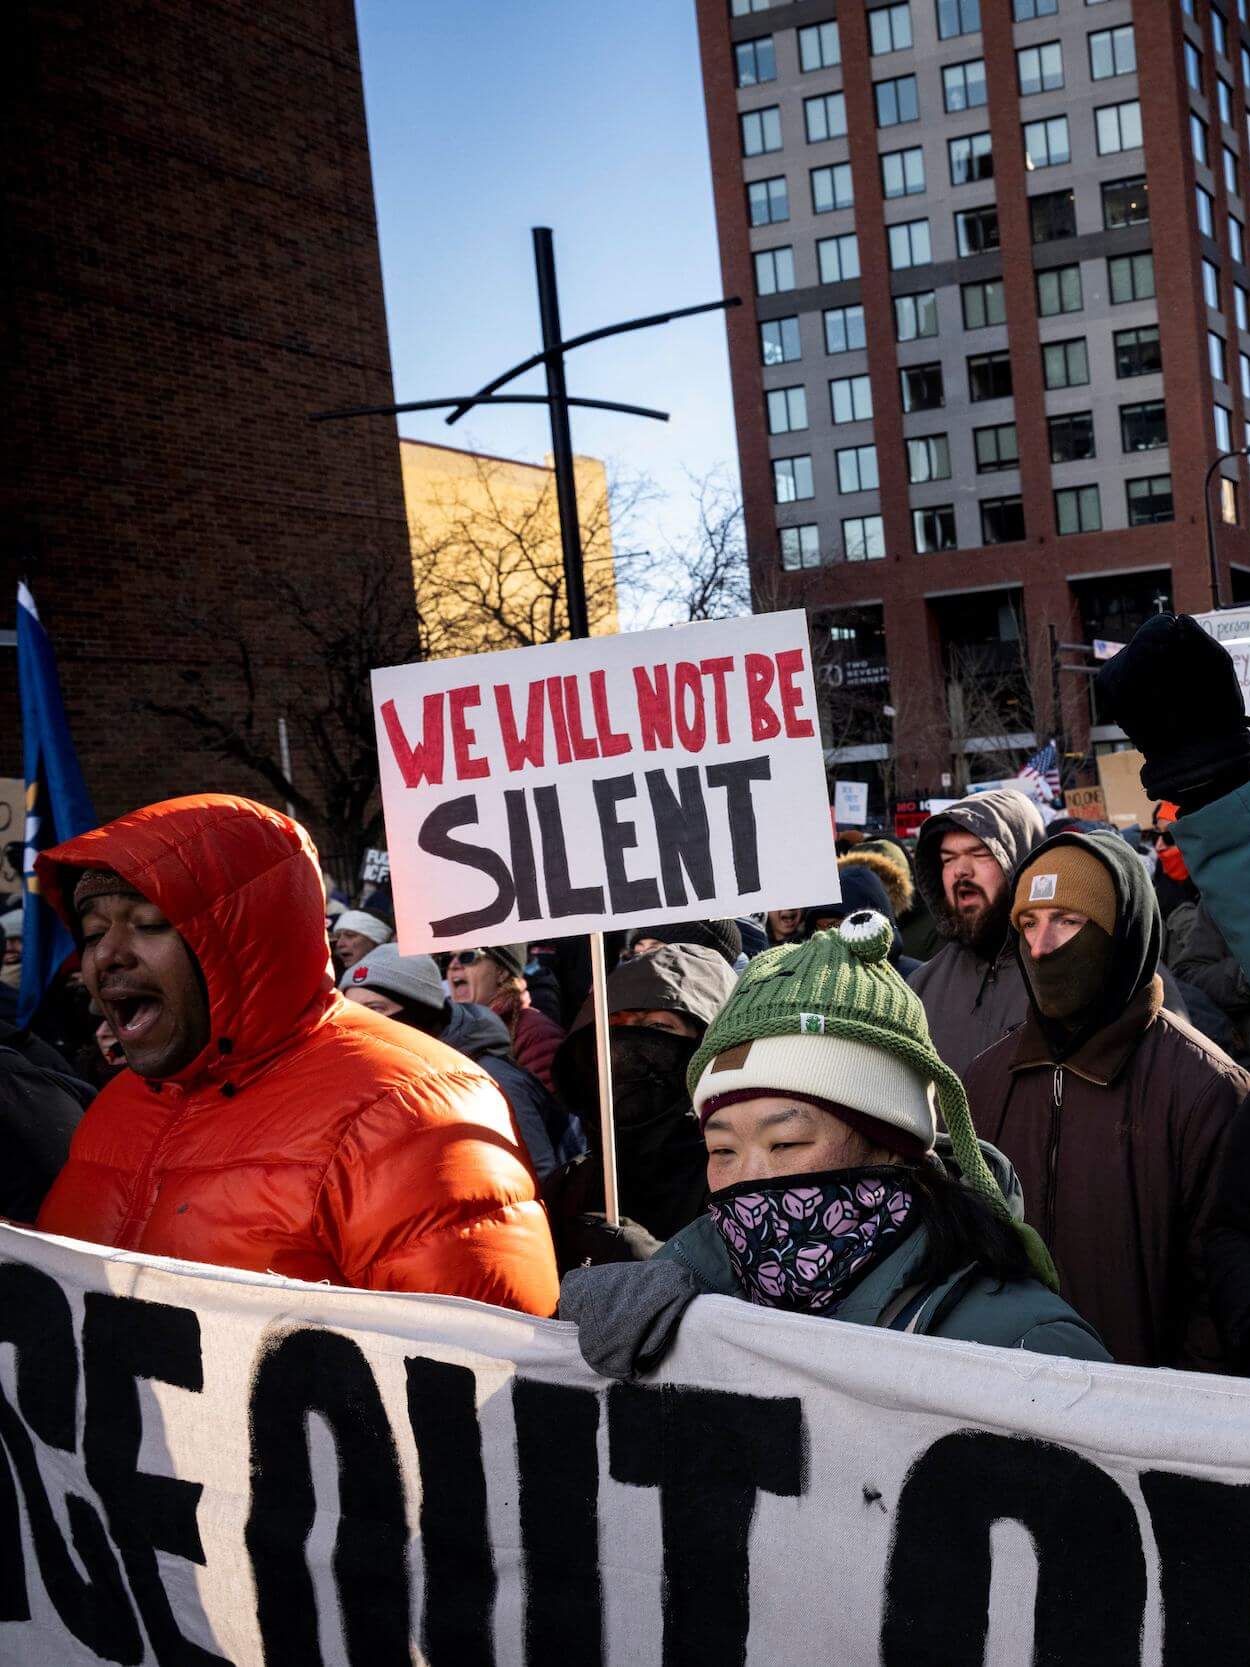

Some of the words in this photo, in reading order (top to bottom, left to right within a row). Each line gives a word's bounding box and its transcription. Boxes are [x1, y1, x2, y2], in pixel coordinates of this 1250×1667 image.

[380, 685, 490, 789] WE
[493, 669, 632, 772] WILL
[632, 656, 735, 754] NOT
[744, 648, 815, 742] BE
[418, 755, 771, 938] SILENT
[245, 1322, 812, 1667] OUT
